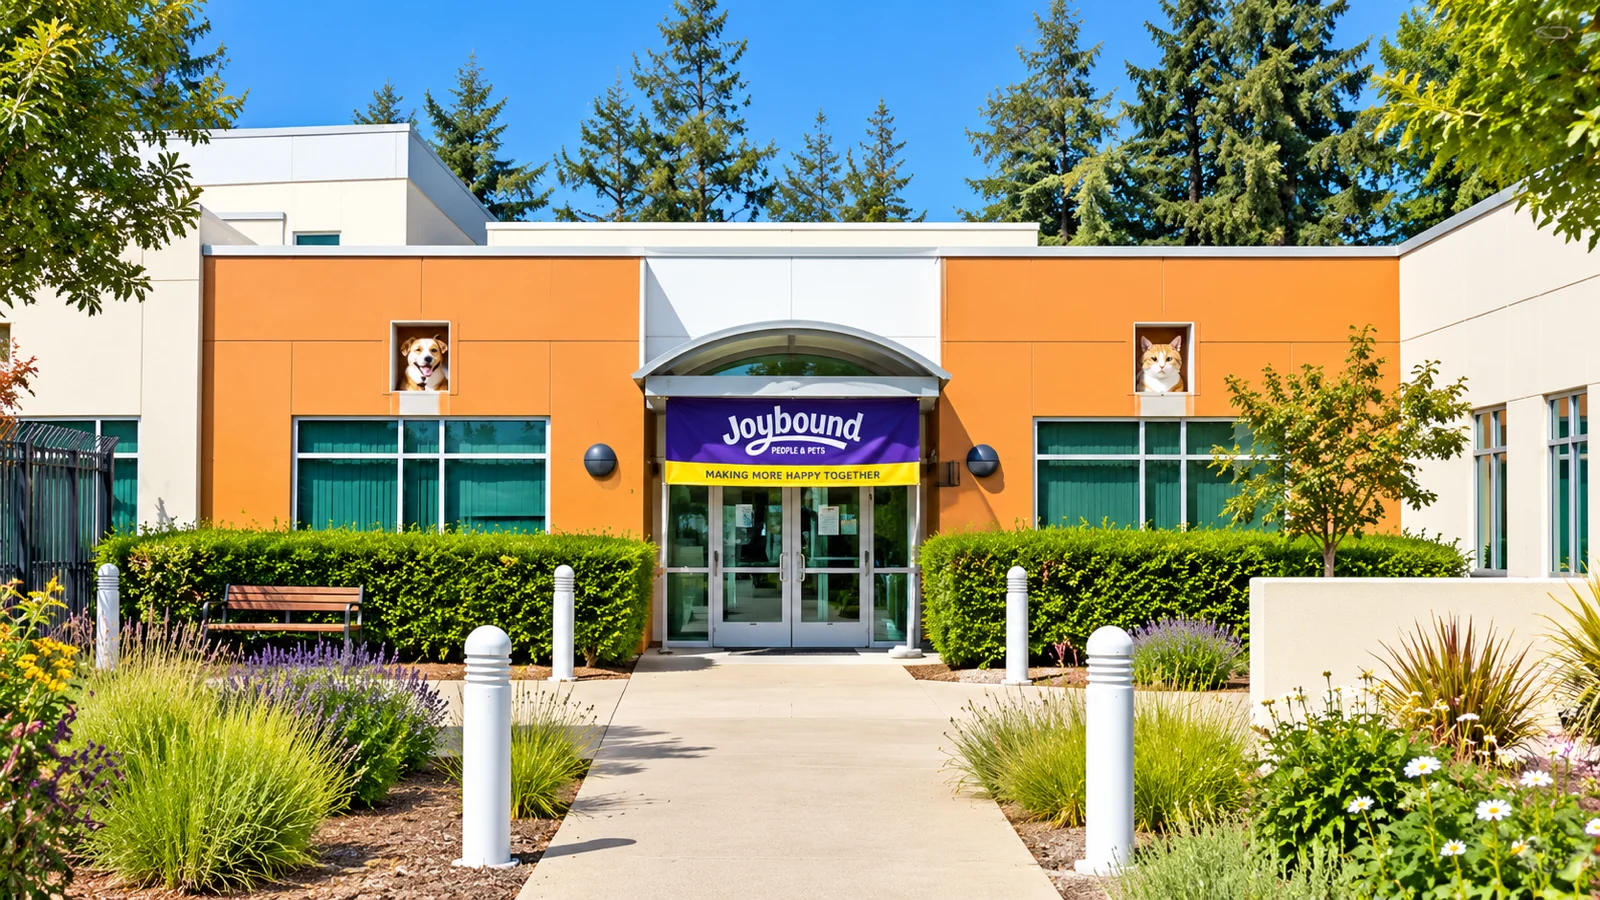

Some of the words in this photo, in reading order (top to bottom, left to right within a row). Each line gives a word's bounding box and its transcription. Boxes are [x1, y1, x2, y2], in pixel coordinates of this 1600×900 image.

[722, 405, 864, 456] Joybound
[771, 446, 798, 455] PEOPLE
[800, 446, 806, 455] &
[807, 446, 826, 455] PETS
[705, 470, 749, 480] MAKING
[752, 470, 782, 480] MORE
[785, 471, 821, 480] HAPPY
[823, 470, 881, 480] TOGETHER
